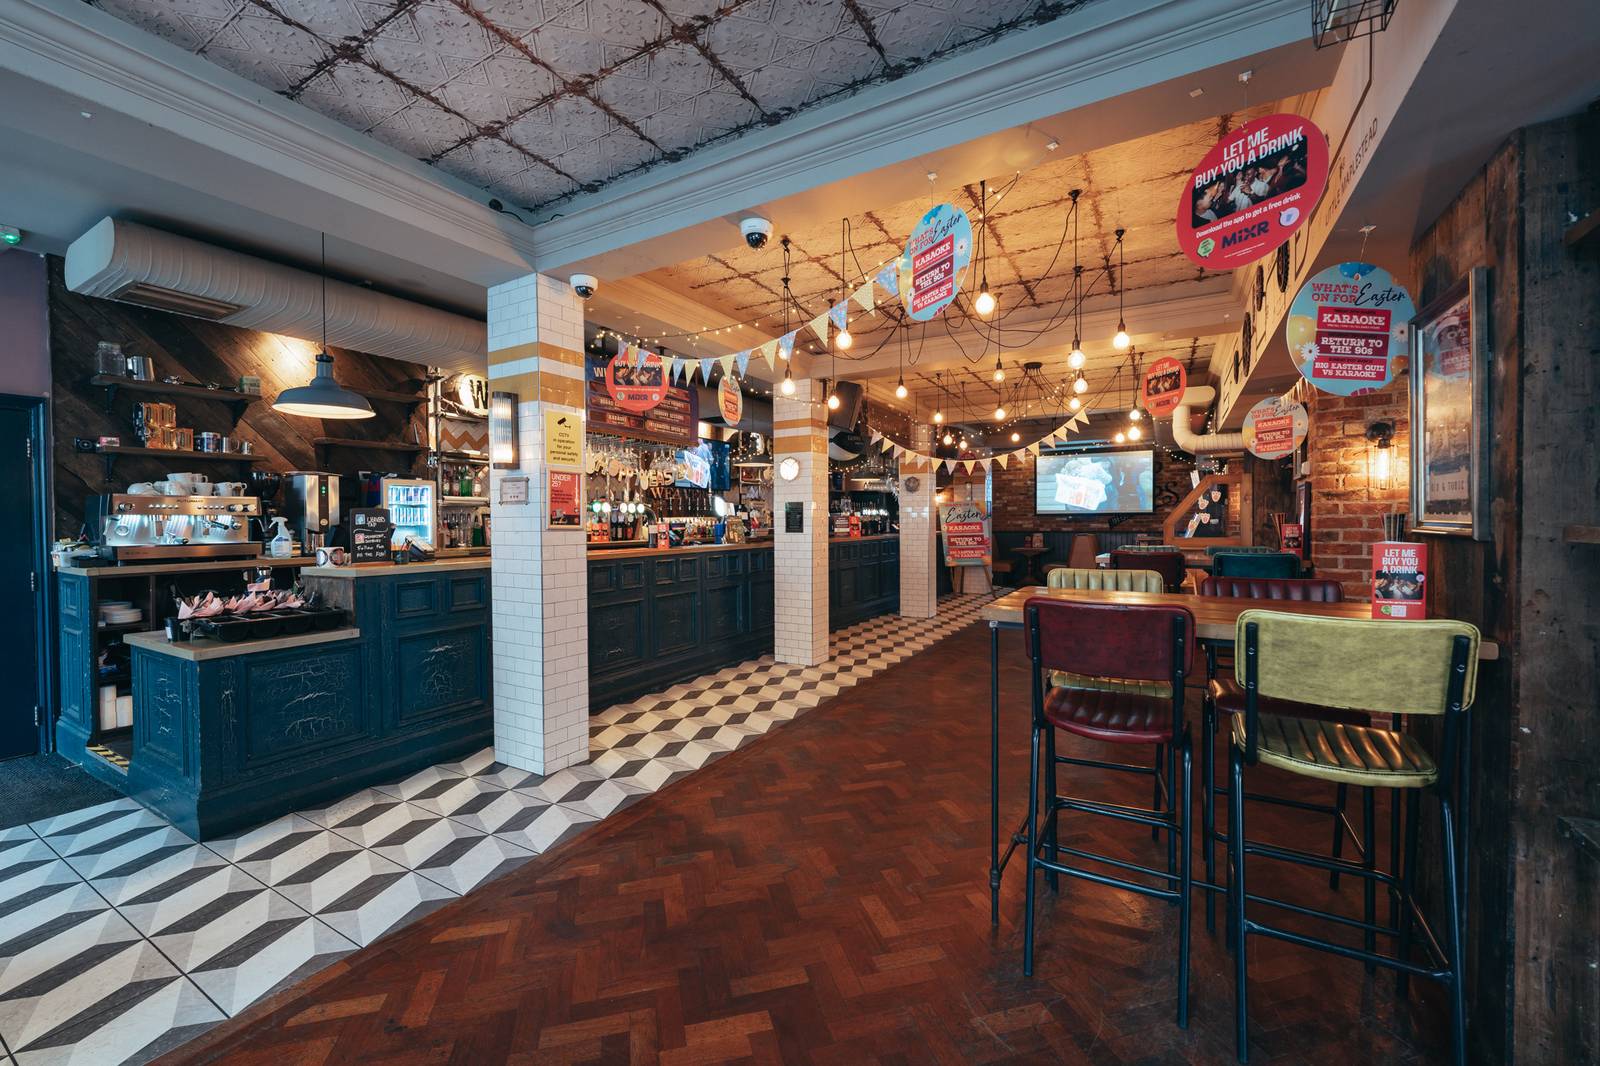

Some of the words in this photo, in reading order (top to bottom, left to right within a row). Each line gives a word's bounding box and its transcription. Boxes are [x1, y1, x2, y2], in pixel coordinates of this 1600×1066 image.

[1223, 138, 1245, 161] LET
[1247, 127, 1269, 148] ME
[1195, 166, 1219, 189] BUY
[1220, 155, 1245, 176] YOU
[1247, 151, 1257, 165] A
[1259, 126, 1304, 161] DRINK
[1233, 216, 1245, 225] app
[1252, 208, 1262, 218] get
[1268, 200, 1282, 210] free
[932, 213, 962, 244] Easter
[915, 242, 951, 268] KARAOKE
[941, 261, 950, 271] TO
[1312, 283, 1359, 294] WHAT'S
[1312, 293, 1329, 303] ON
[1333, 294, 1357, 304] FOR
[1355, 283, 1406, 306] Easter
[1322, 313, 1385, 326] KARAOKE
[1321, 336, 1365, 348] RETURN
[1368, 339, 1383, 348] TO
[1330, 345, 1352, 354] THE
[1315, 361, 1329, 369] BIG
[1331, 362, 1363, 371] EASTER
[1364, 364, 1384, 372] QUIZ
[1335, 370, 1377, 378] KARAOKE
[551, 473, 571, 481] UNDER
[946, 507, 981, 523] Easter
[1385, 549, 1400, 557] LET
[1402, 549, 1416, 557] ME
[1382, 557, 1400, 565] BUY
[1401, 557, 1418, 566] YOU
[1382, 565, 1389, 574] A
[1390, 566, 1418, 574] DRINK
